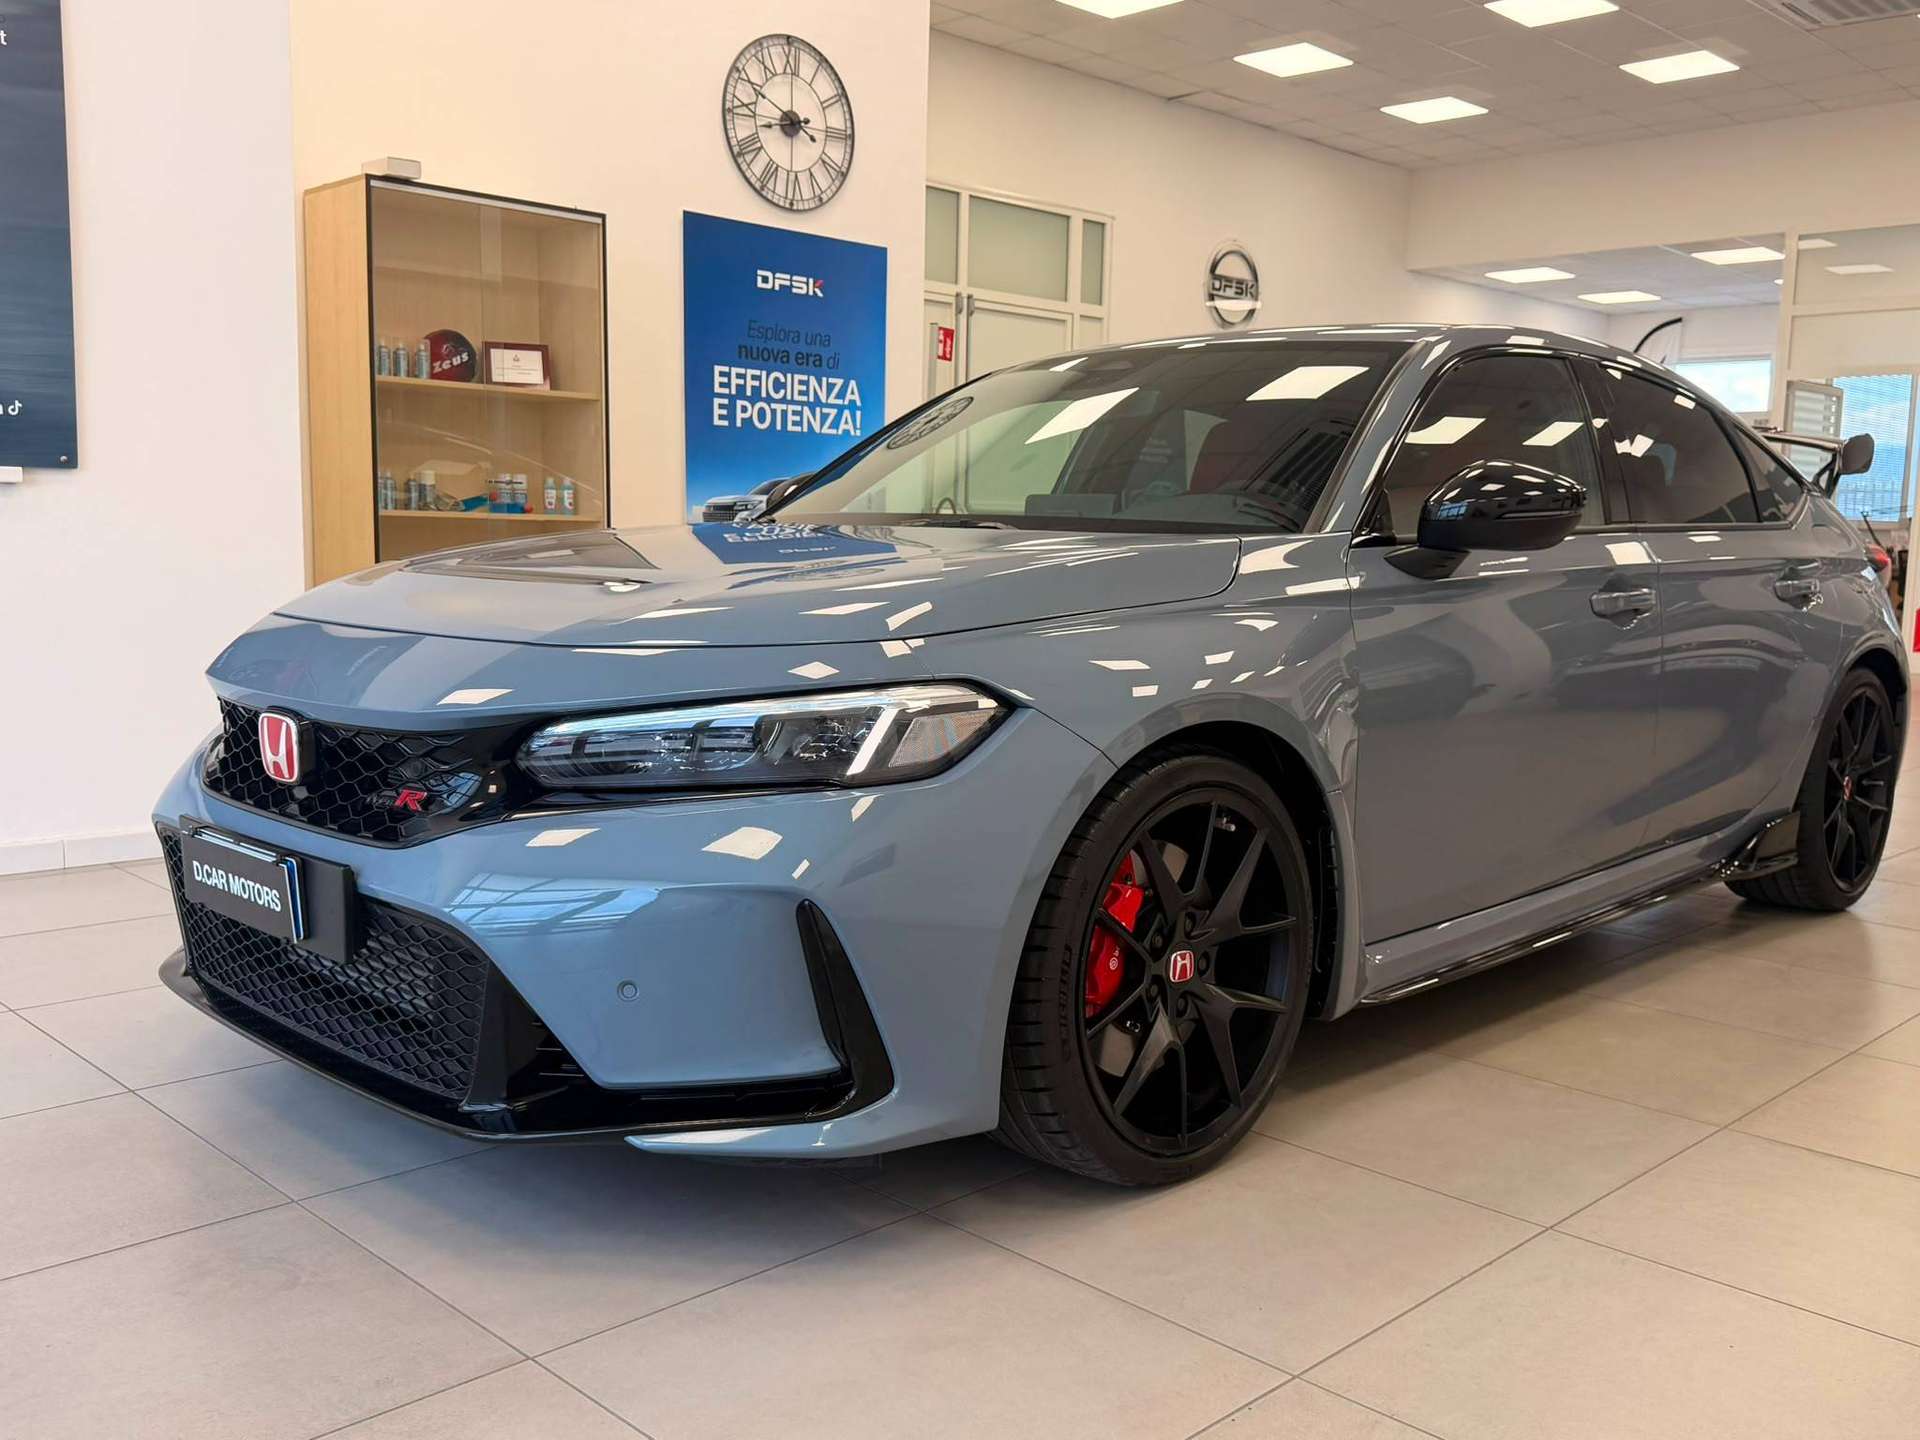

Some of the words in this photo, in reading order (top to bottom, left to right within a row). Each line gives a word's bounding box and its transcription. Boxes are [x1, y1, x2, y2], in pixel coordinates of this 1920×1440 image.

[757, 269, 824, 297] DFSK
[1211, 278, 1255, 298] DFSK
[748, 320, 800, 345] Esplora
[805, 331, 832, 347] una
[737, 343, 790, 364] nuova
[795, 351, 823, 367] era
[826, 352, 840, 369] di
[713, 365, 862, 407] EFFICIENZA
[713, 398, 729, 427] E
[735, 399, 861, 437] POTENZA!
[394, 789, 427, 812] R
[192, 860, 228, 892] D.CAR
[228, 873, 281, 912] MOTORS
